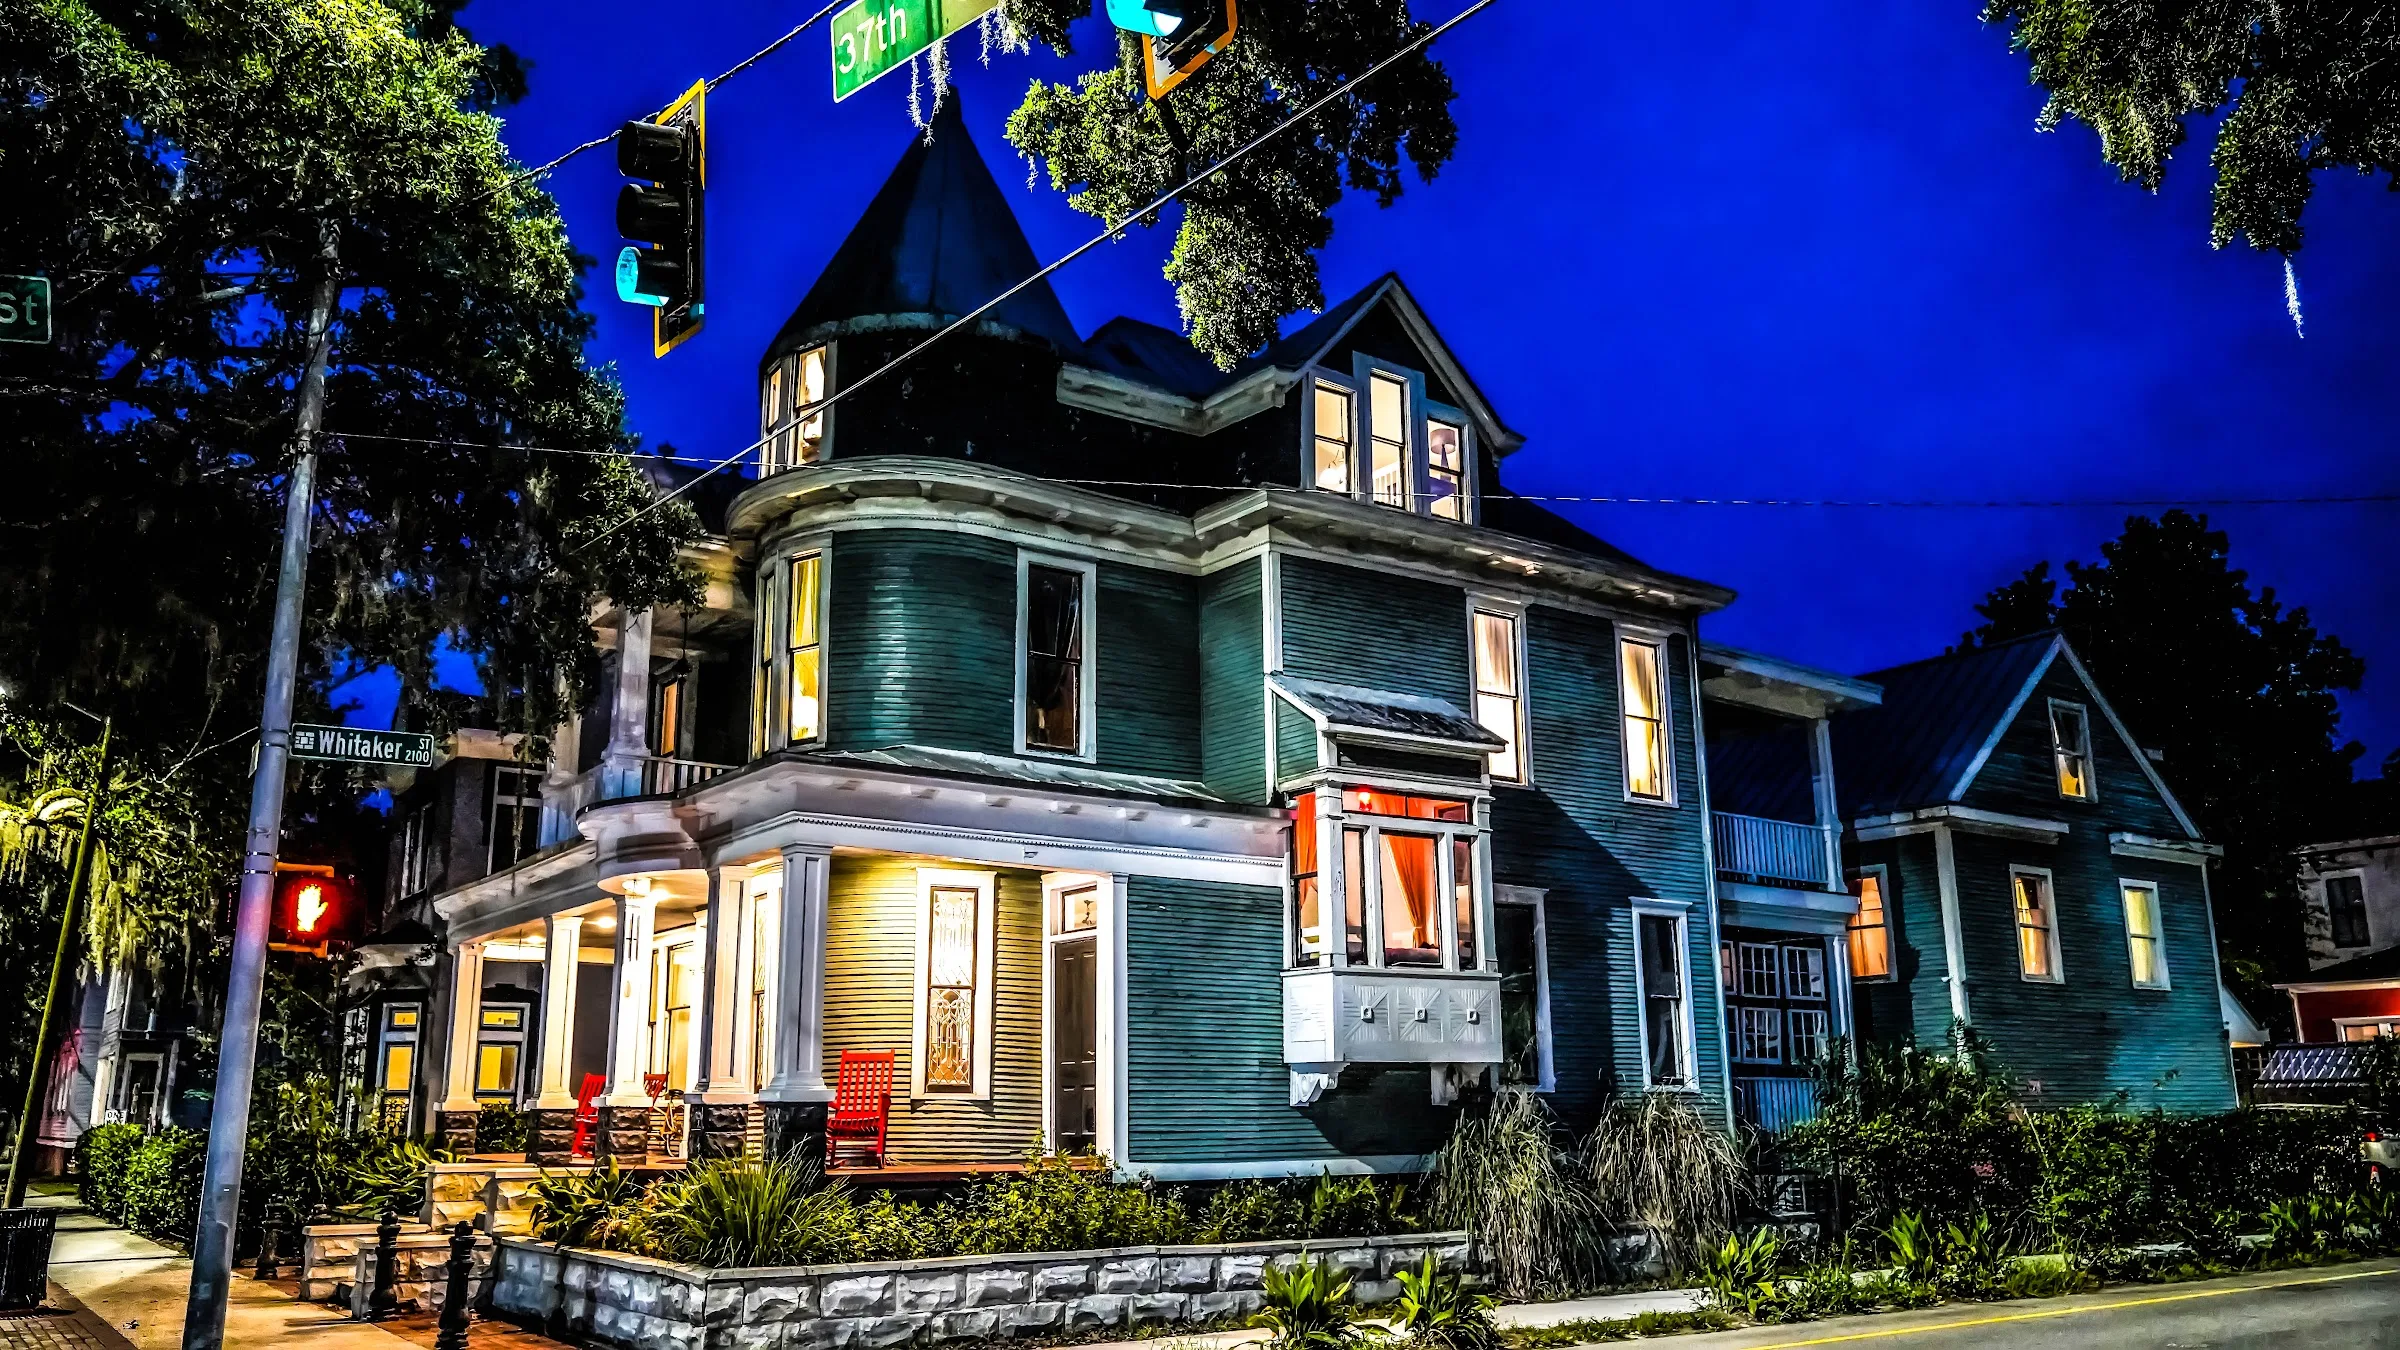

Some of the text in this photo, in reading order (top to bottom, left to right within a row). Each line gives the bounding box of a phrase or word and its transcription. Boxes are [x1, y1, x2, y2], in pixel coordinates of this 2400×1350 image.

[839, 3, 907, 74] 37th
[0, 291, 38, 326] St
[318, 730, 431, 760] Whitaker ST
[404, 749, 430, 763] 2100
